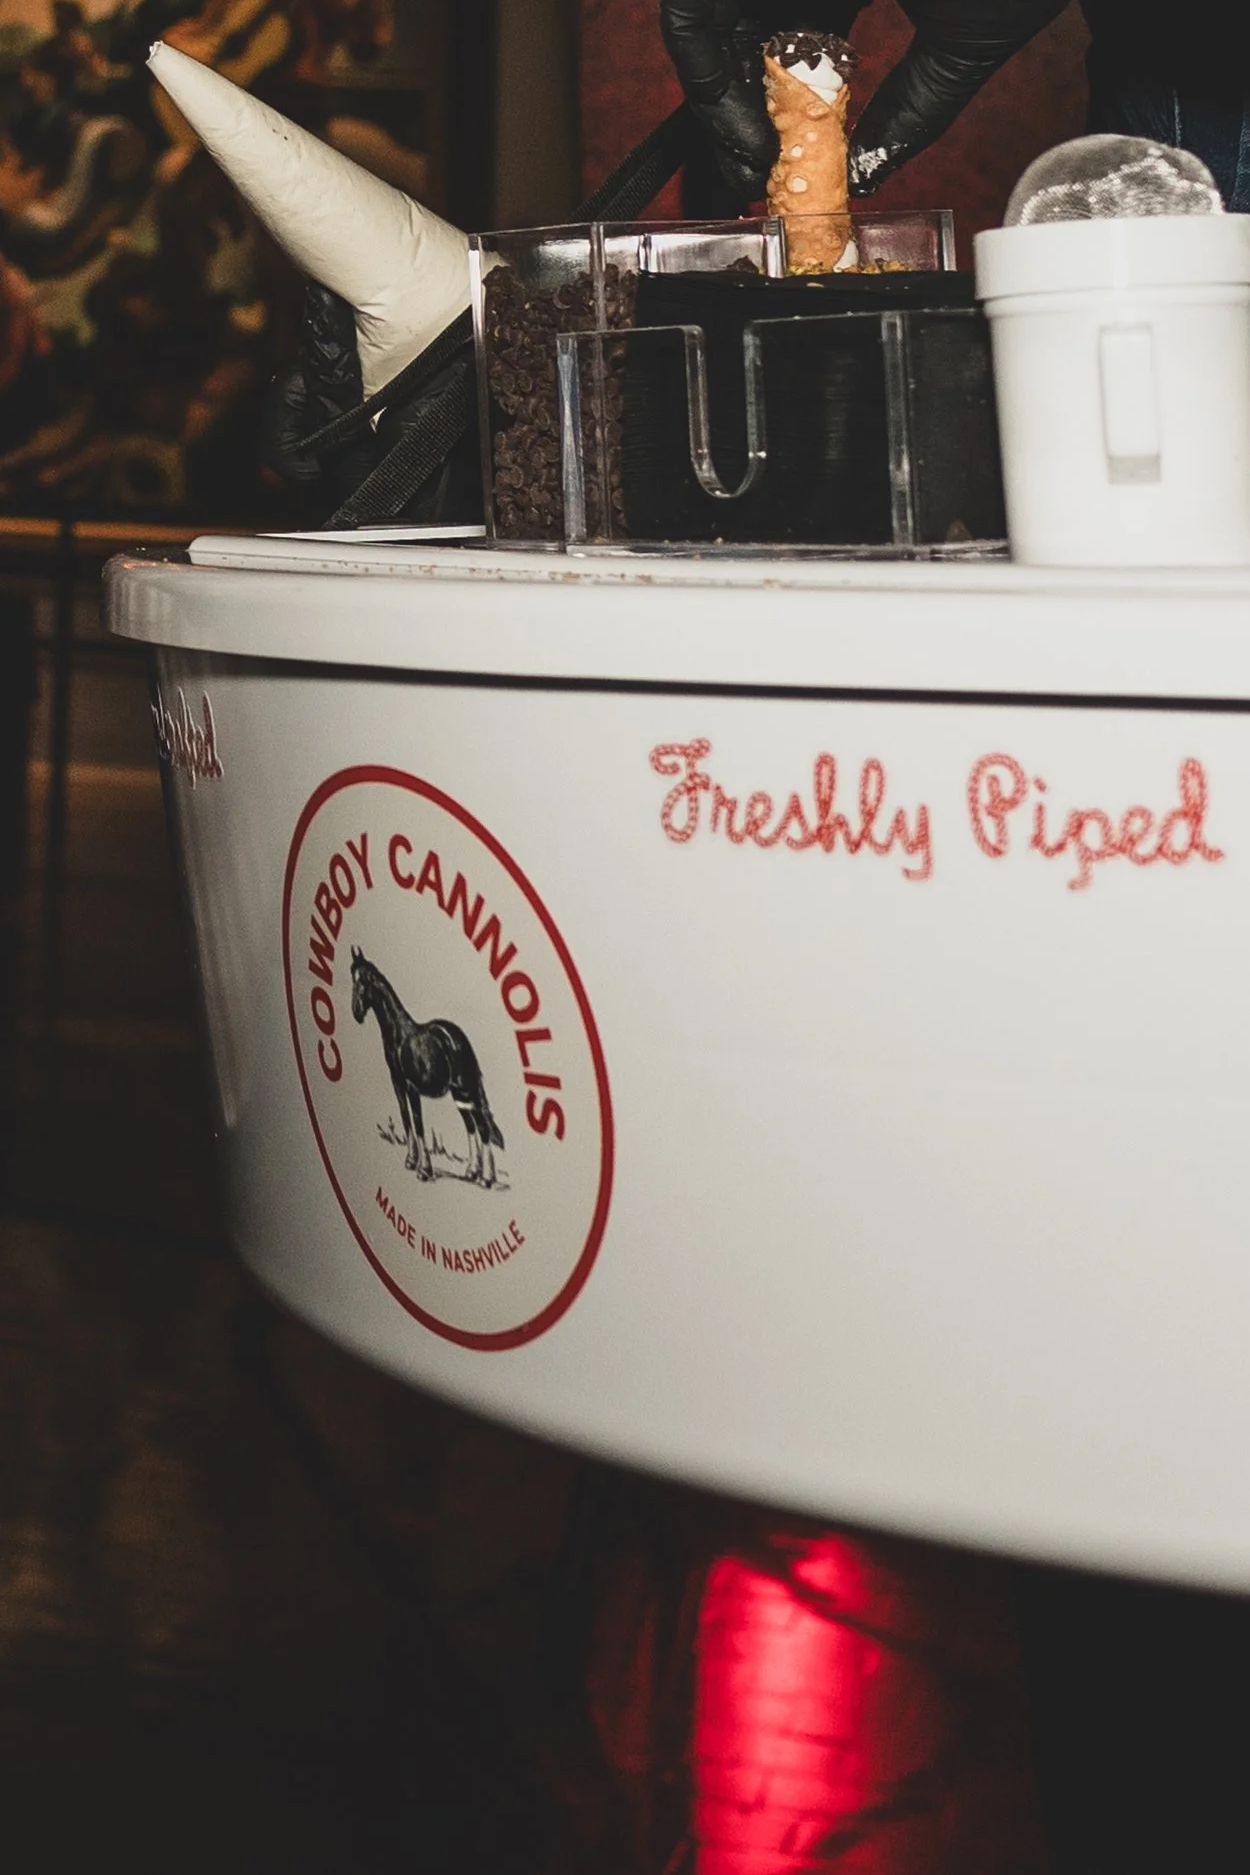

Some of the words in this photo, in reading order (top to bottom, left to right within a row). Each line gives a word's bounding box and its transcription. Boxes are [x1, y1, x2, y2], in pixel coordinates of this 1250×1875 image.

[650, 738, 932, 881] Freshly
[968, 752, 1224, 890] Piped
[308, 833, 374, 1082] COWBOY
[387, 833, 567, 1142] CANNOLIS
[375, 1186, 416, 1249] MADE
[421, 1236, 437, 1264] IN
[441, 1219, 525, 1274] NASHVILLE
